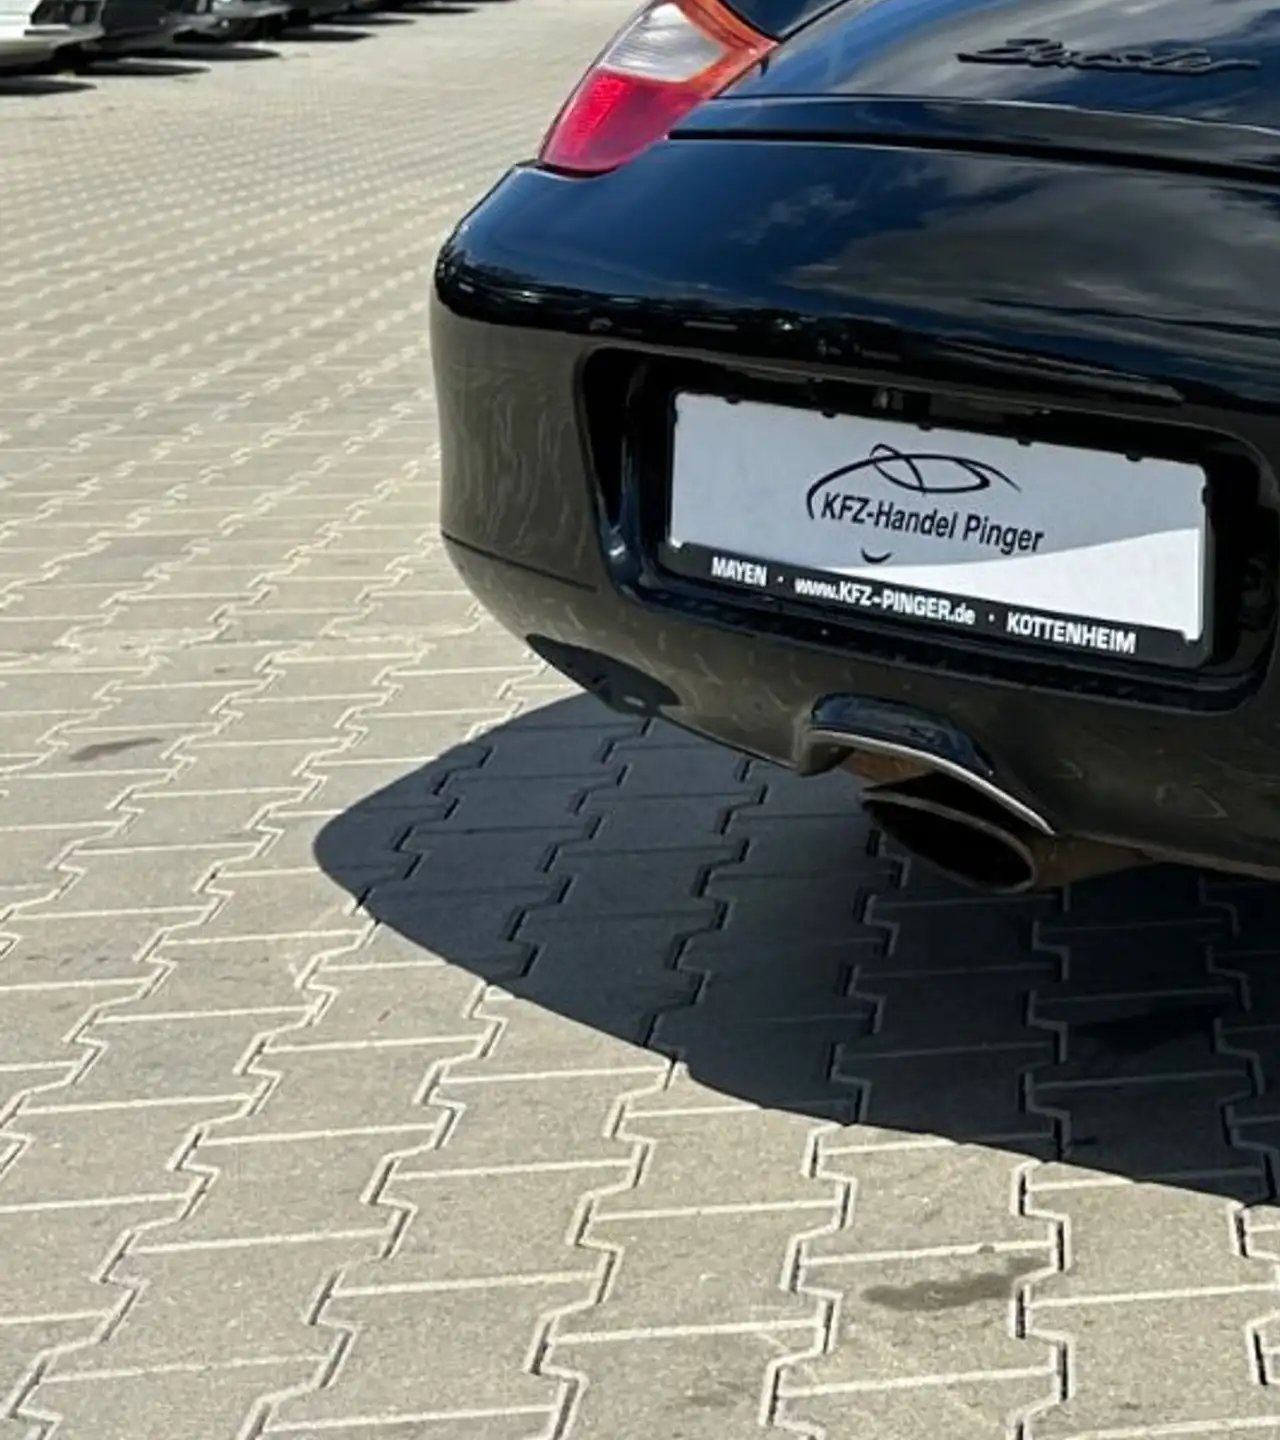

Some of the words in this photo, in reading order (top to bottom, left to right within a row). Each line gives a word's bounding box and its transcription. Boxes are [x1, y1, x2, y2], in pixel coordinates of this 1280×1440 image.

[820, 491, 958, 539] KFZ-Handel
[963, 513, 1045, 555] Pinger
[711, 556, 768, 587] MAYEN
[794, 577, 976, 625] www.KFZ-PINGER.de
[1006, 611, 1137, 654] KOTTENHEIM
